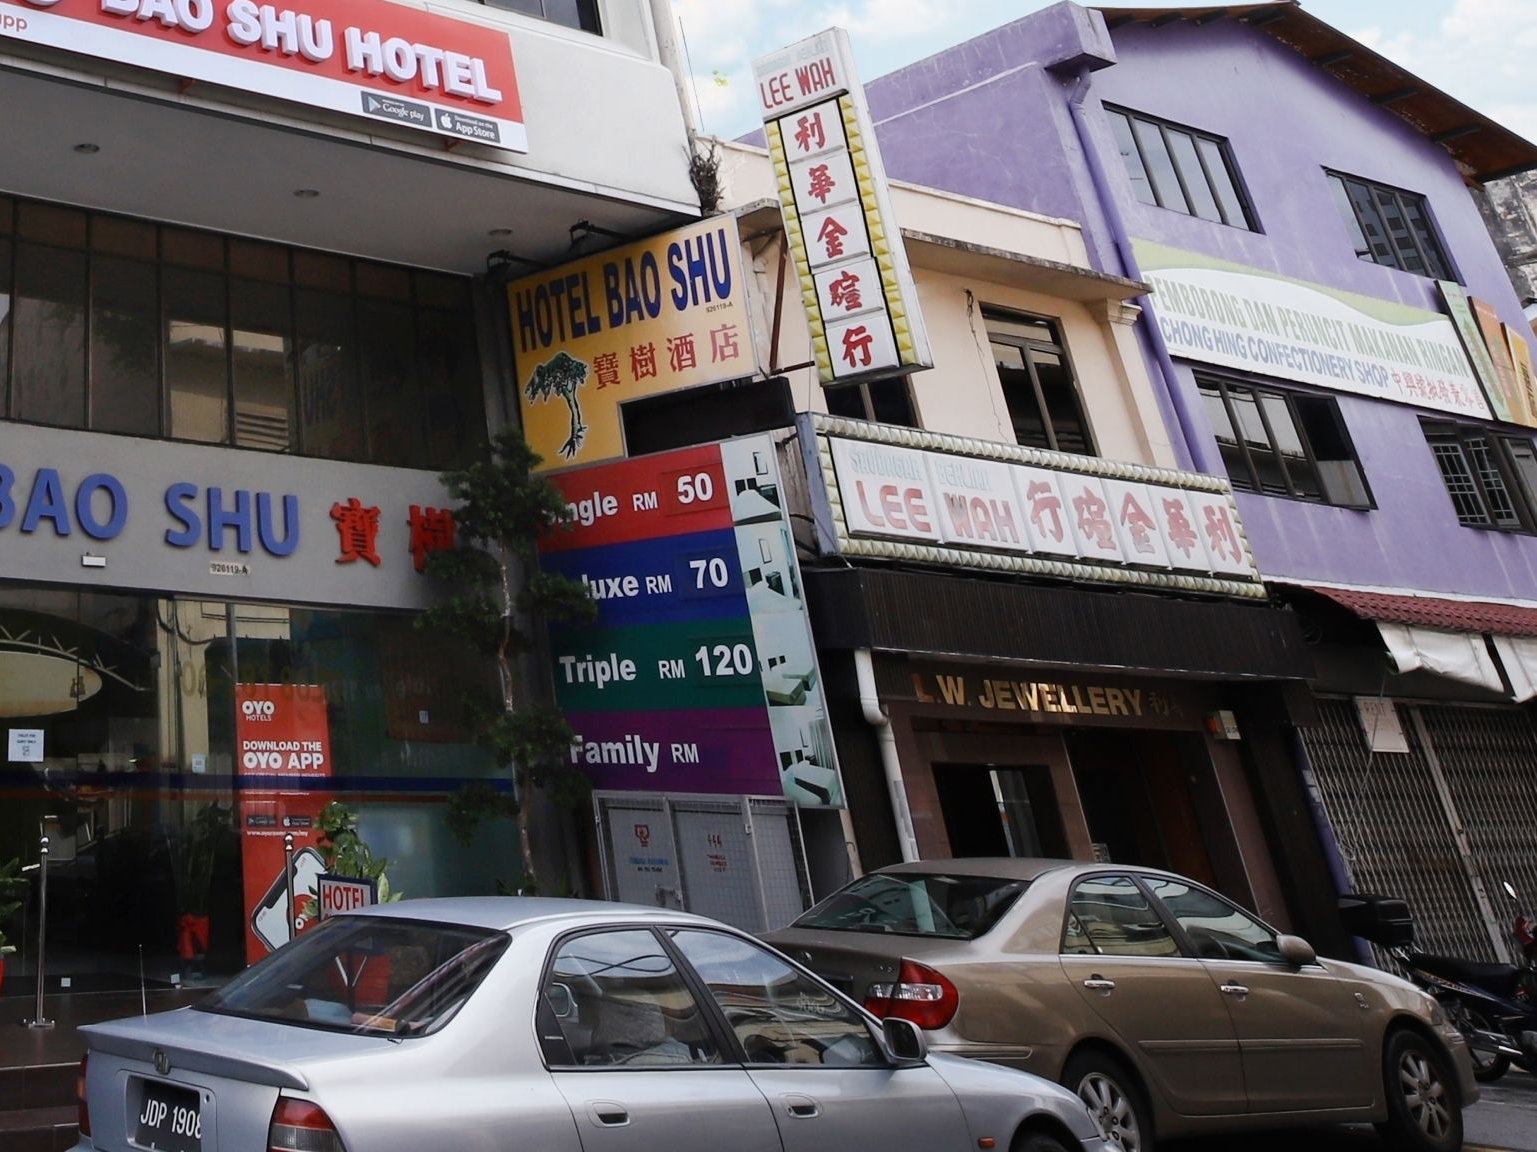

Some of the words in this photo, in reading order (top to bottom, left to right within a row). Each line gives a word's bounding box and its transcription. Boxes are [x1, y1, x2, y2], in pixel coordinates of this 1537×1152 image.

[344, 26, 503, 105] HOTEL
[760, 72, 794, 109] LEE
[794, 57, 836, 97] WAH
[382, 102, 408, 118] Google
[455, 121, 473, 136] App
[474, 127, 495, 140] Store
[516, 271, 602, 353] HOTEL
[603, 250, 661, 329] BAO
[667, 228, 732, 311] SHU
[593, 324, 739, 390] 寶樹酒店
[1160, 316, 1215, 352] CHONG
[1212, 329, 1248, 360] HING
[1246, 335, 1356, 382] CONFECTIONERY
[1353, 360, 1389, 389] SHOP
[165, 482, 299, 557] SHU
[542, 491, 618, 526] ngle
[632, 491, 658, 512] RM
[677, 472, 713, 504] 50
[855, 480, 932, 533] LEE
[942, 491, 1020, 544] WAH
[581, 573, 639, 600] luxe
[645, 574, 672, 595] RM
[689, 557, 728, 589] 70
[559, 653, 637, 689] Triple
[658, 659, 686, 679] RM
[695, 643, 753, 677] 120
[242, 701, 275, 715] OYO
[246, 714, 272, 722] HOTELS
[979, 679, 1143, 717] JEWELLERY
[243, 740, 300, 752] DOWNLOAD
[302, 741, 322, 751] THE
[243, 751, 283, 769] OYO
[288, 752, 324, 770] APP
[569, 734, 659, 773] Family
[670, 743, 699, 764] RM
[140, 1099, 168, 1129] JDP
